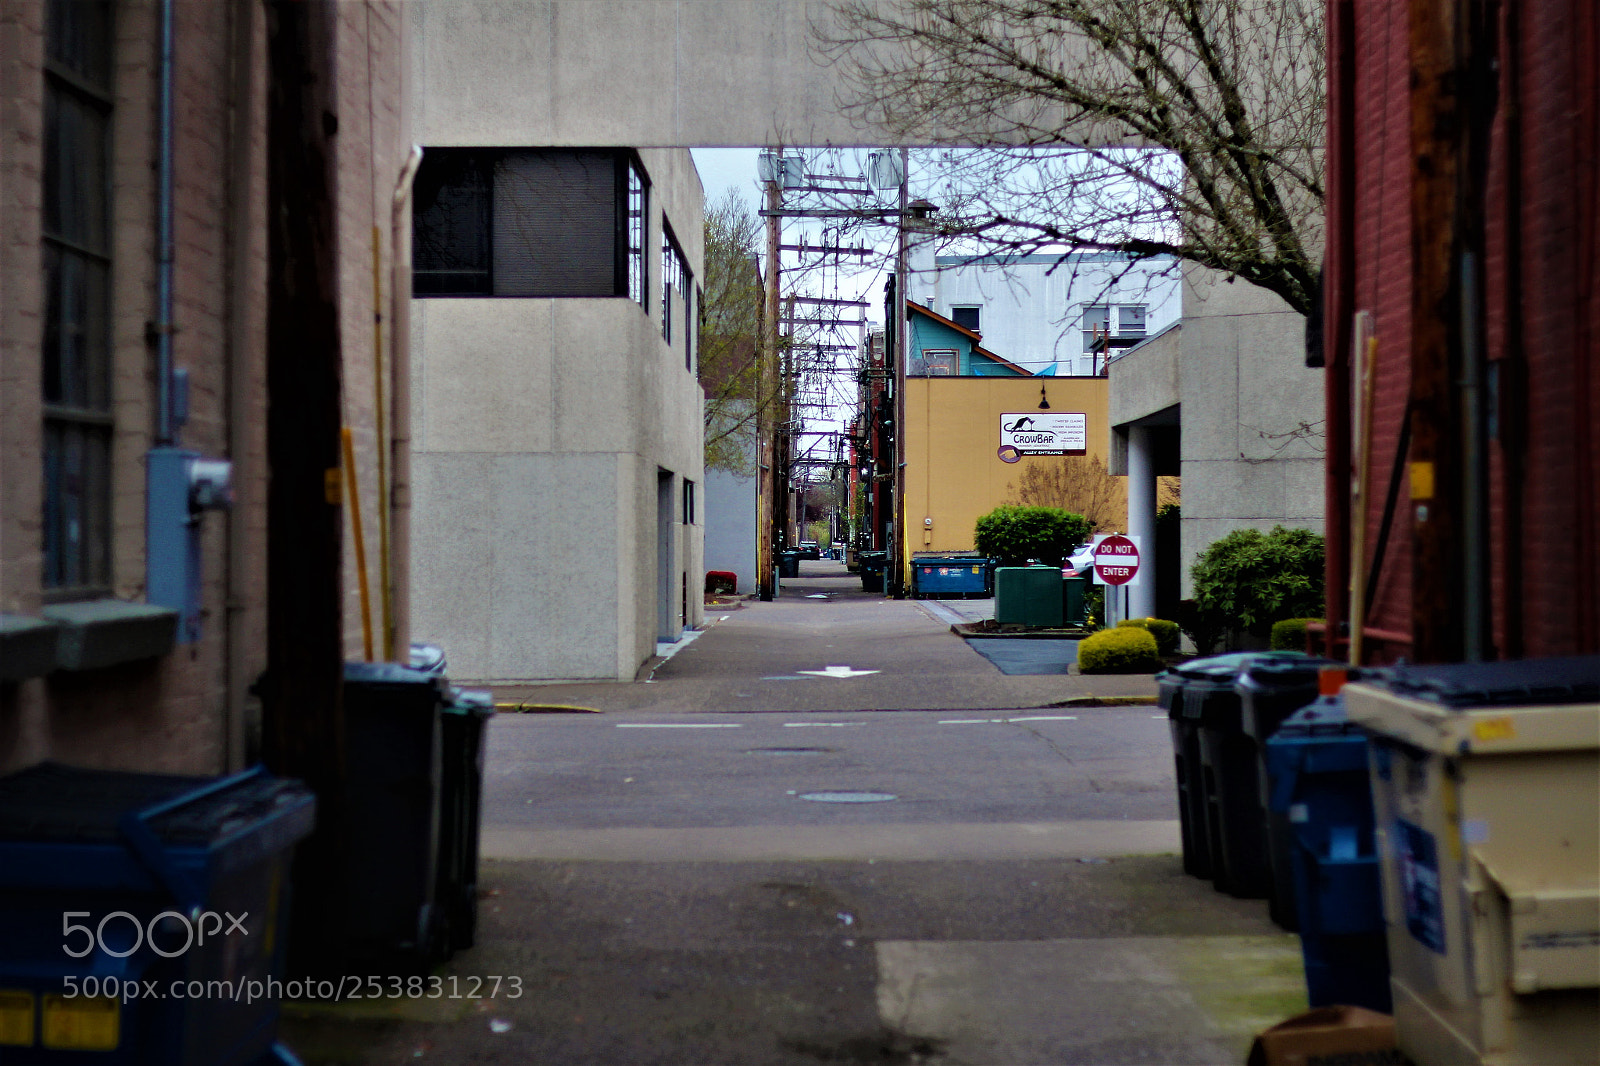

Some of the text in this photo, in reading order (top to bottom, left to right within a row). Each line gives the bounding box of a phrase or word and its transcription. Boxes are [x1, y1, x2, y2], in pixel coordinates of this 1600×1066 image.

[1101, 545, 1132, 554] DO NOT
[1103, 567, 1129, 576] ENTER
